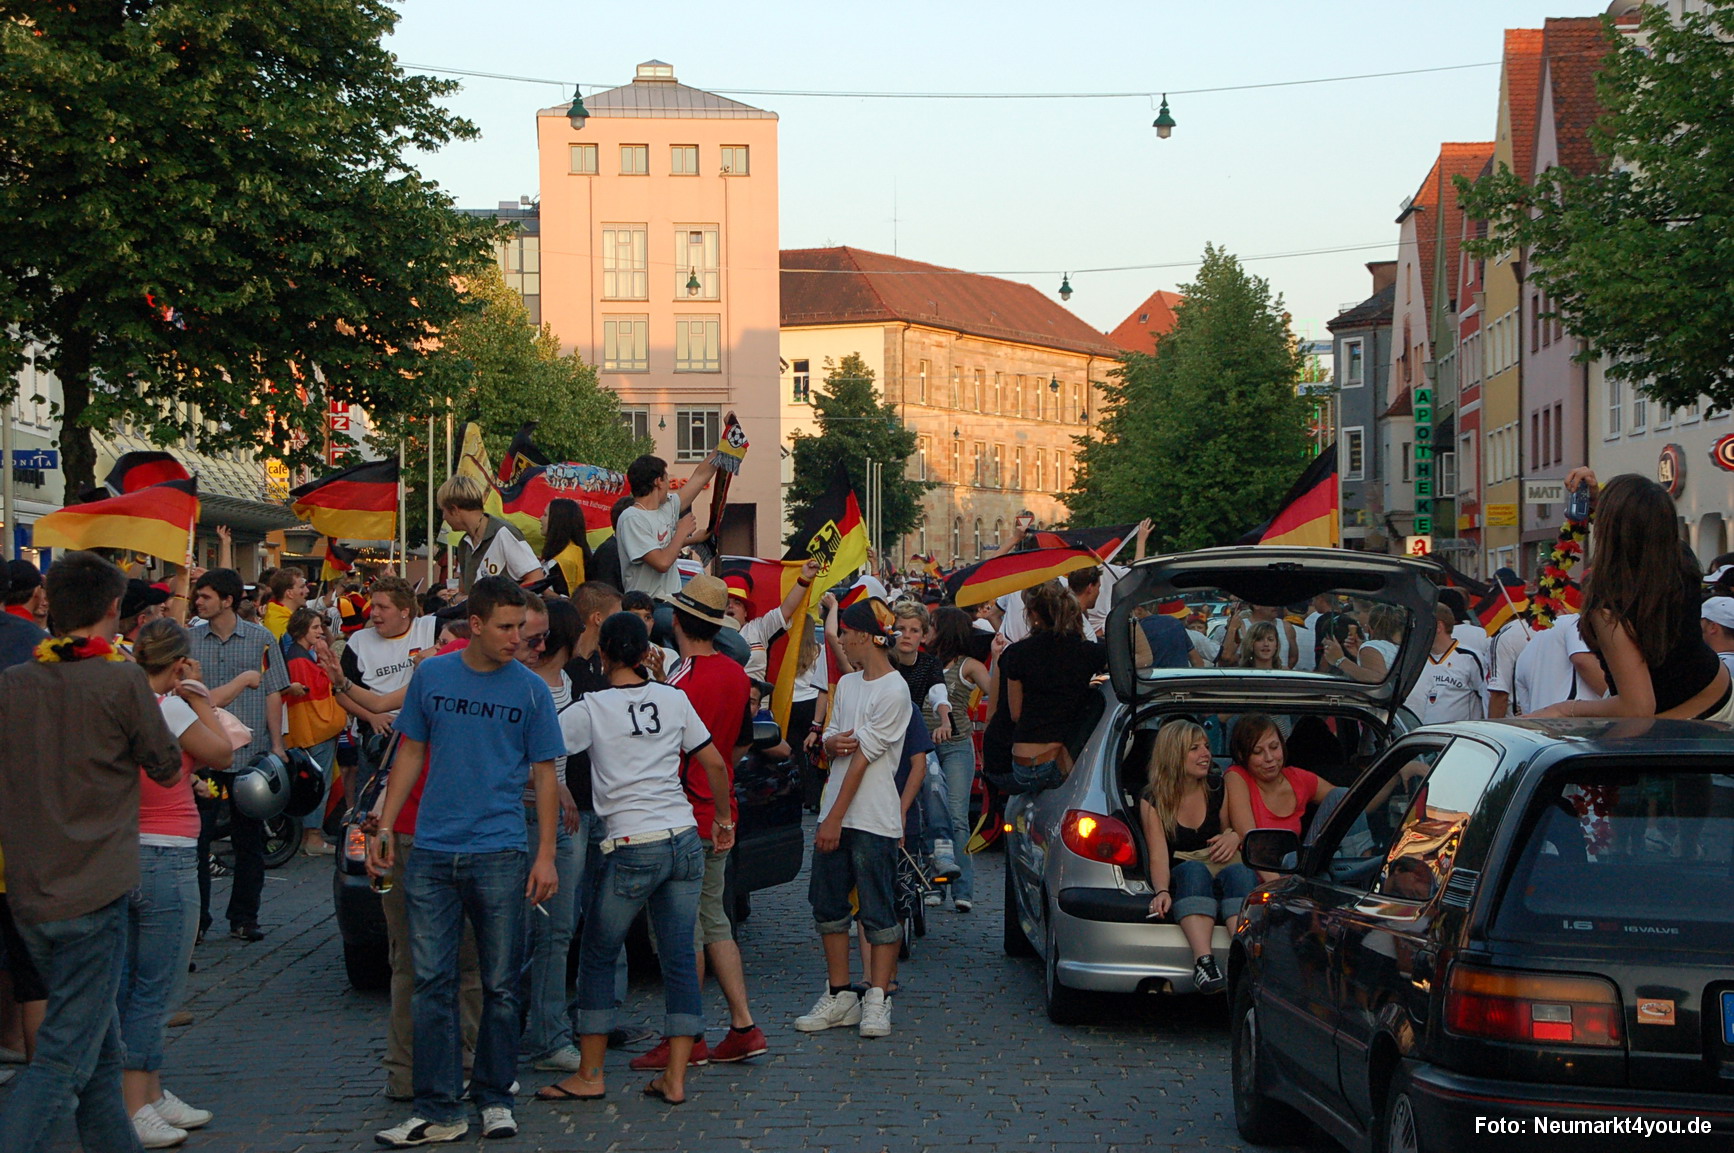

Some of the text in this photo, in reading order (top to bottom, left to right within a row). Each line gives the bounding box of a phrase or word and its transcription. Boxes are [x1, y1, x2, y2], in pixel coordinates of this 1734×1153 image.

[1416, 390, 1431, 531] APOTHEKE
[1528, 486, 1562, 499] MATT
[484, 557, 498, 575] 10
[1433, 675, 1463, 689] HLAND
[432, 695, 523, 724] TORONTO
[627, 701, 661, 736] 13
